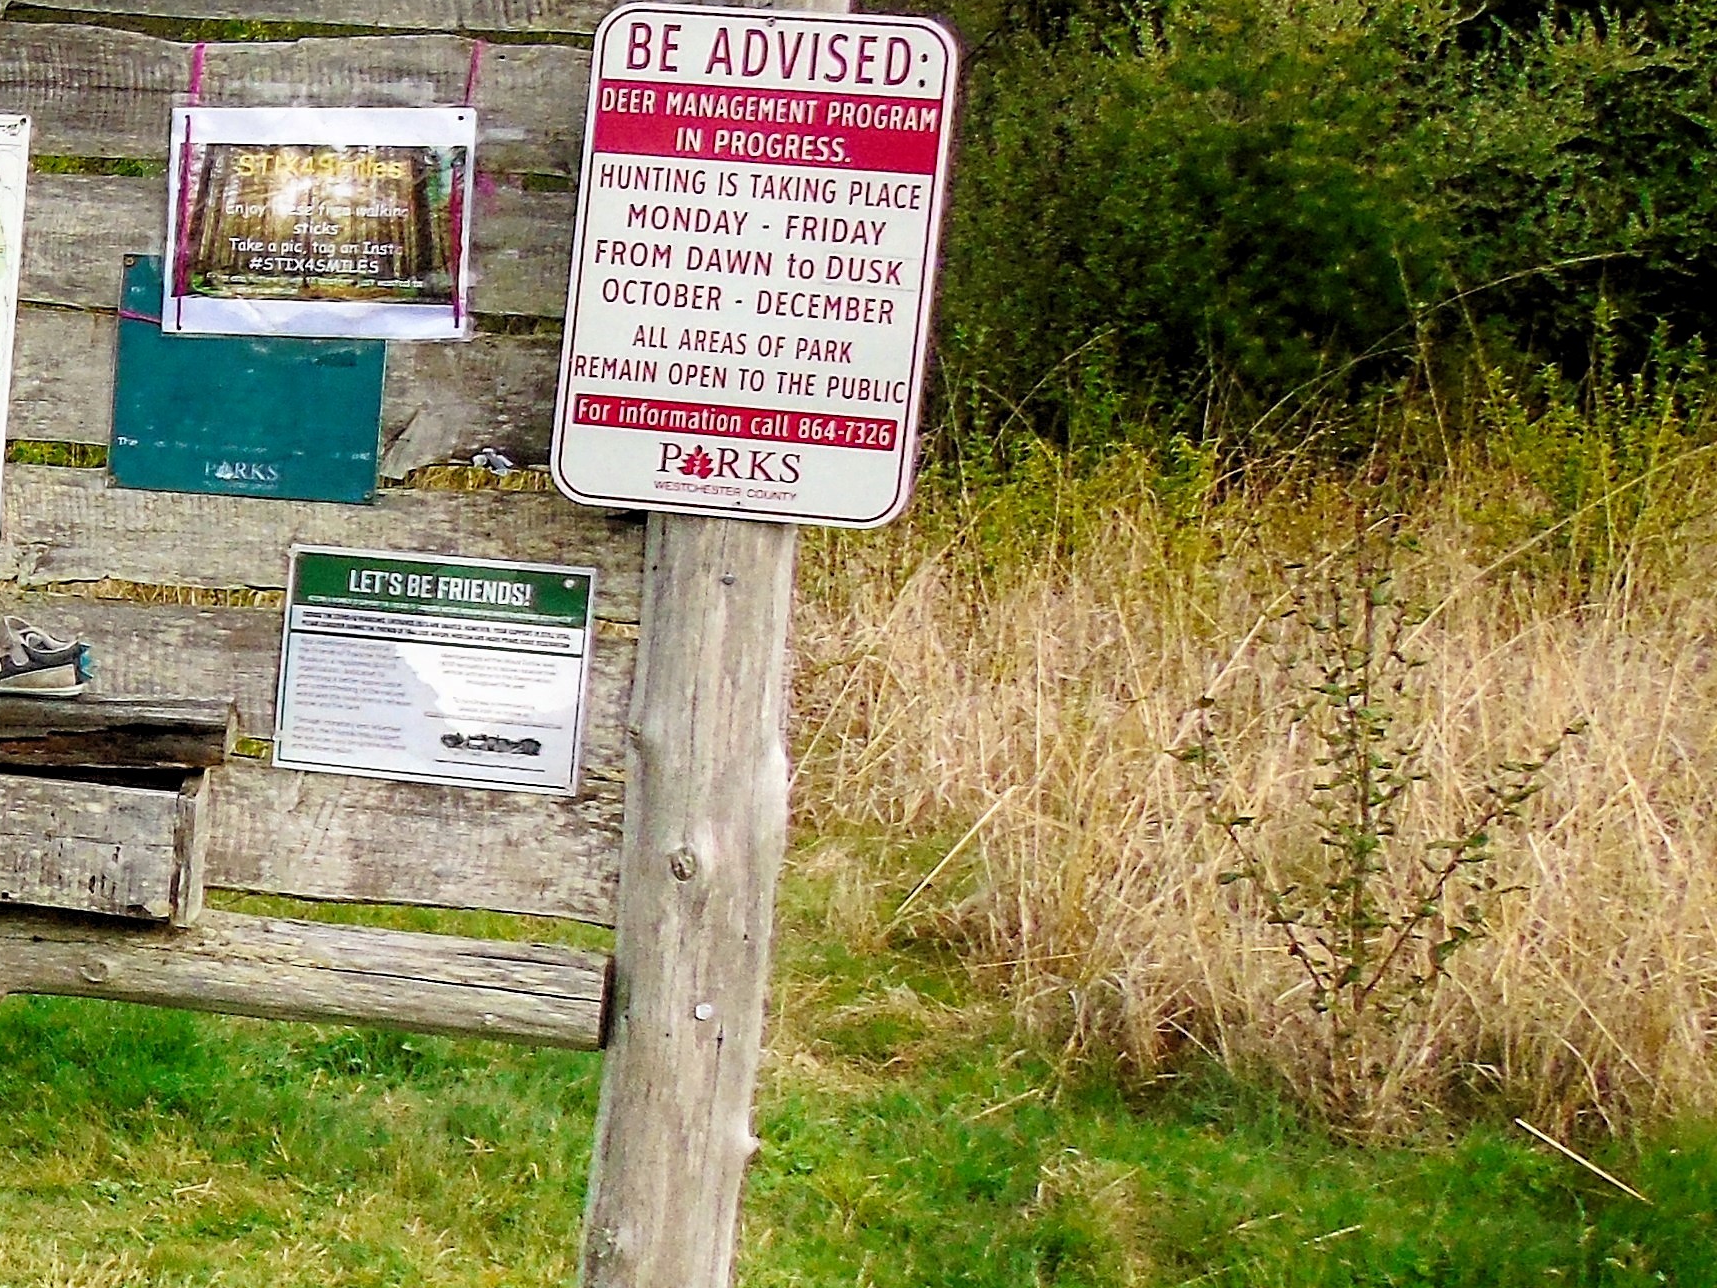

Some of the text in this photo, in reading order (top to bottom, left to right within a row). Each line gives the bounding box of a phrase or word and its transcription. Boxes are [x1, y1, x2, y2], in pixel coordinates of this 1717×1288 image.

[626, 22, 929, 89] BE ADVISED:
[601, 88, 938, 132] DEER MANAGEMENT PROGRAM
[675, 129, 852, 164] IN PROGRESS.
[599, 164, 922, 210] HUNTING IS TAKING PLACE
[225, 202, 267, 218] Enjoy
[293, 223, 339, 235] sticks
[627, 204, 748, 237] MONDAY
[785, 215, 887, 246] FRIDAY
[229, 238, 264, 252] Take
[268, 242, 276, 252] a
[280, 240, 307, 255] pic,
[313, 241, 335, 257] tag
[248, 257, 379, 274] #STIX4SMILES
[595, 239, 903, 286] FROM DAWN to DUSK
[602, 279, 721, 311] OCTOBER
[756, 291, 894, 325] DECEMBER
[632, 324, 852, 364] ALL AREAS OF PARK
[574, 355, 906, 404] REMAIN OPEN TO THE PUBLIC
[578, 399, 890, 446] For information call 864-7326
[656, 442, 801, 484] PARKS
[654, 480, 797, 501] WESTCHESTER COUNTY
[349, 570, 531, 606] LET'S BE FRIENDS!
